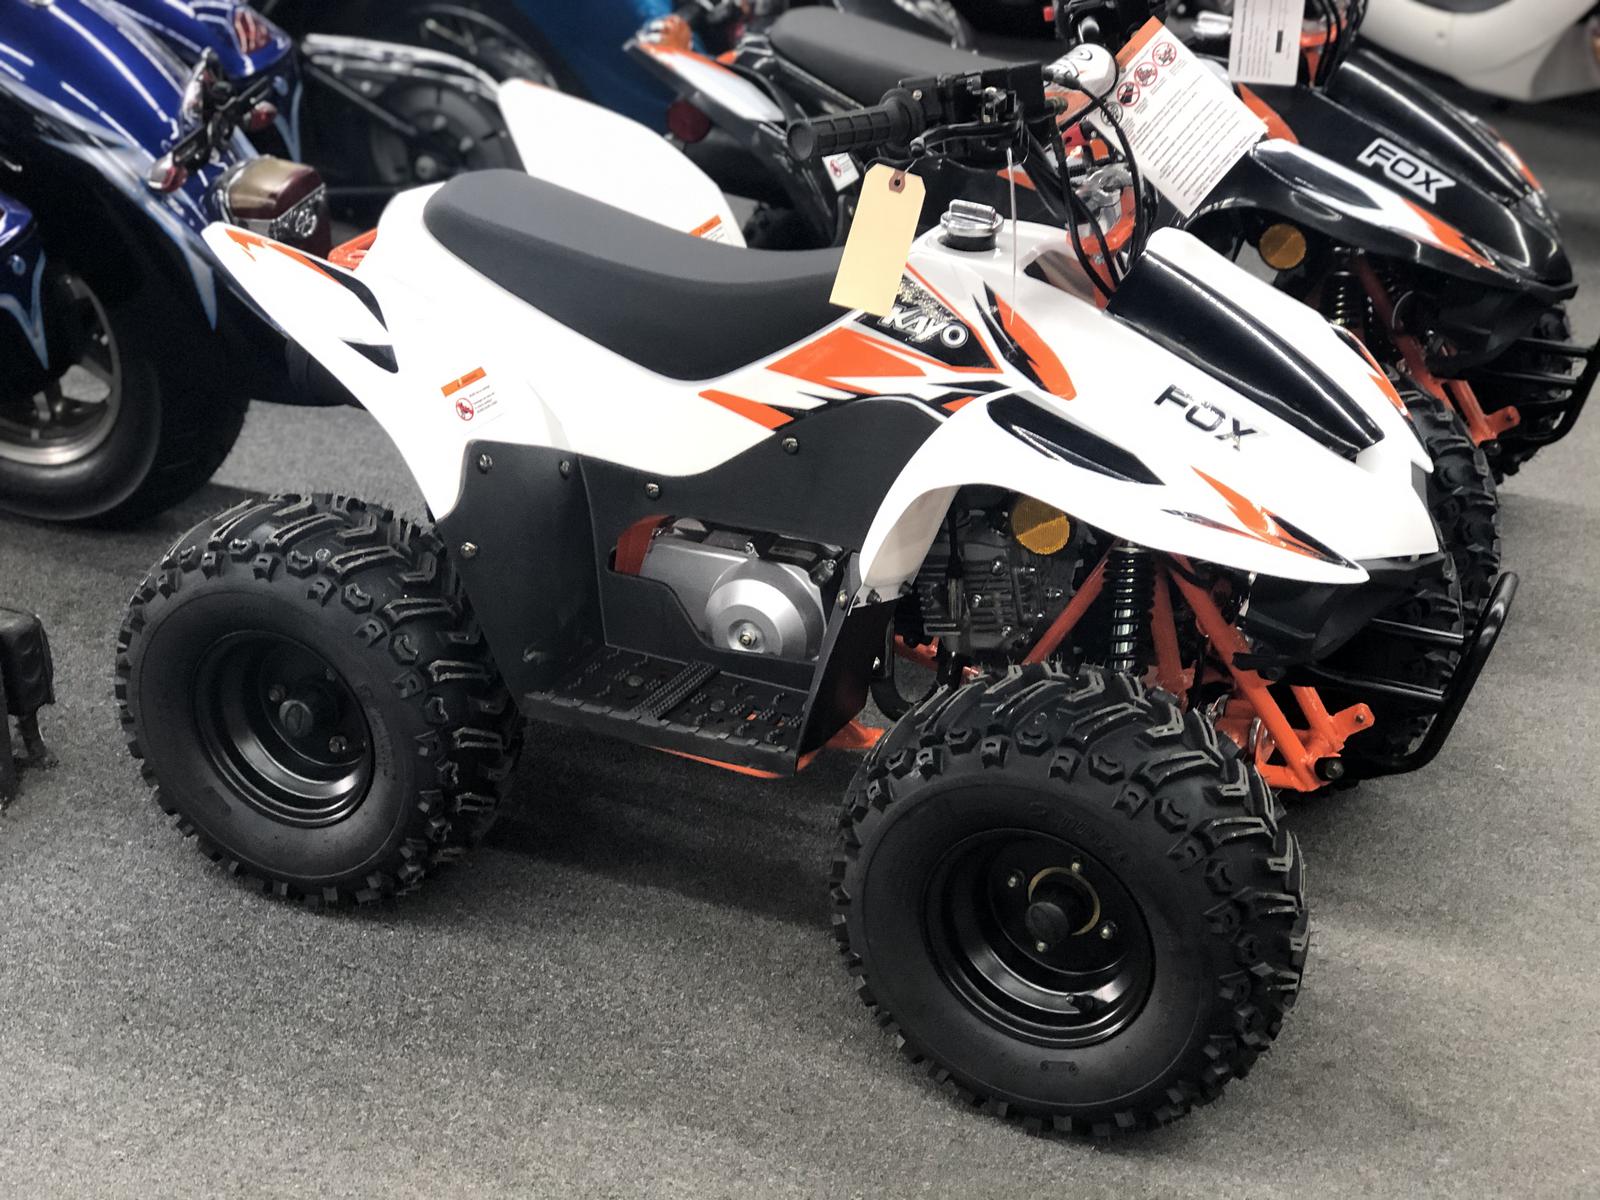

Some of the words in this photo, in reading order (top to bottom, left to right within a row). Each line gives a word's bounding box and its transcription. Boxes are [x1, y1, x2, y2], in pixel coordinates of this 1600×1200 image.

[1358, 139, 1454, 203] FOX
[878, 304, 968, 348] KAYO
[1154, 384, 1258, 451] FOX
